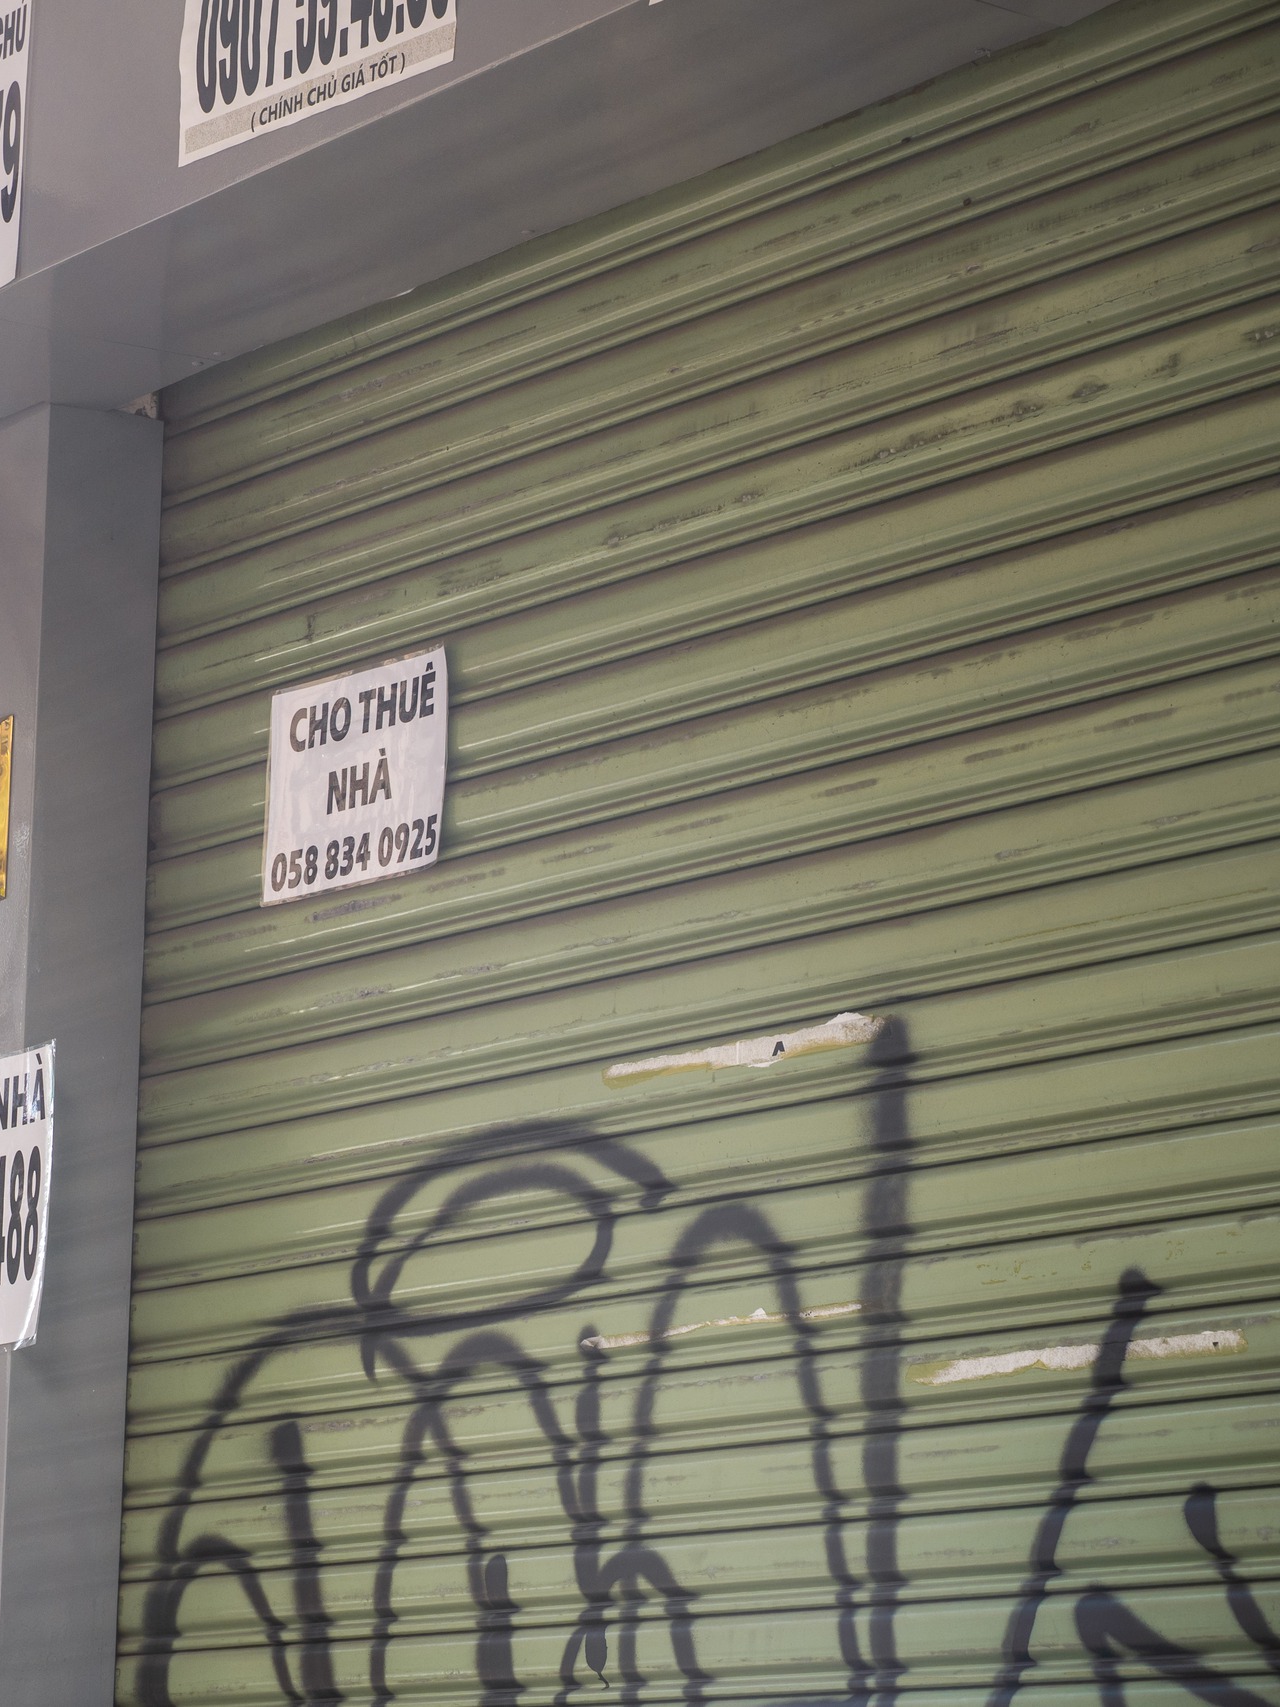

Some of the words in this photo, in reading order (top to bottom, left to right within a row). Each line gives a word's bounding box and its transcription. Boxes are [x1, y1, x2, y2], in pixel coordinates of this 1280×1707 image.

[289, 697, 351, 753] CHO
[359, 661, 436, 735] THUÊ
[326, 747, 392, 815] NHÀ
[271, 845, 318, 892] 058
[325, 832, 371, 880] 834
[377, 814, 438, 867] 0925
